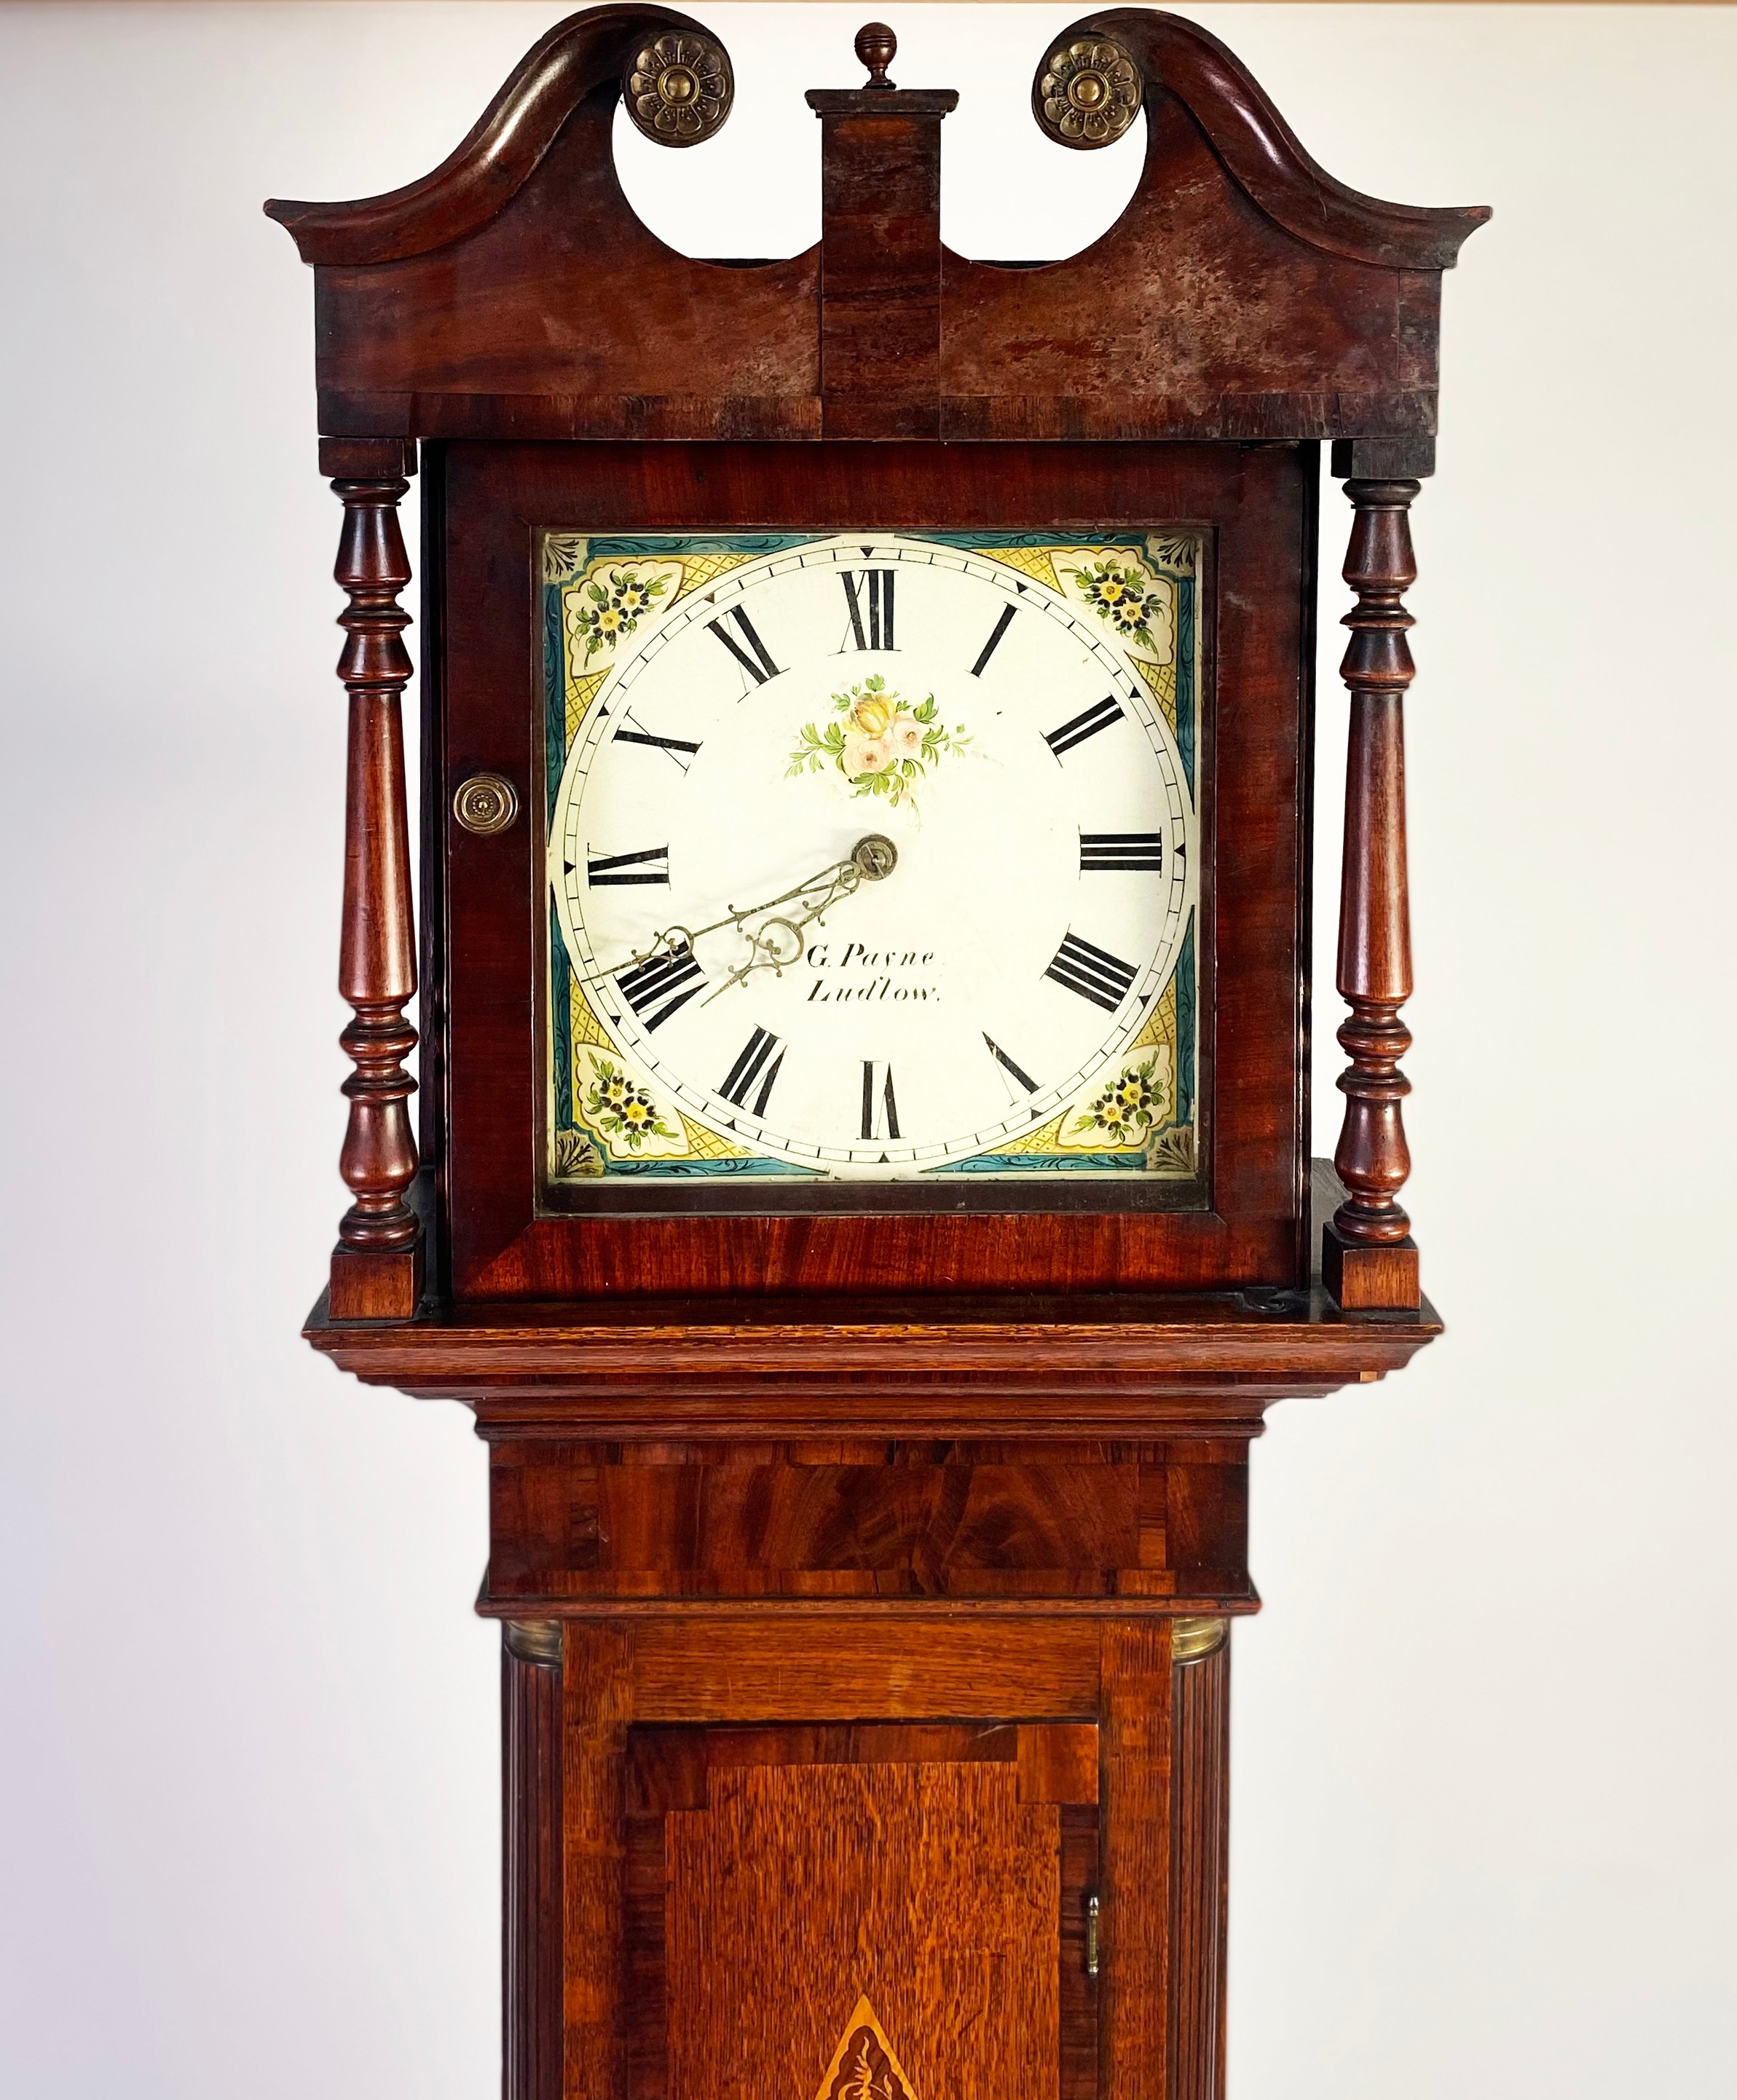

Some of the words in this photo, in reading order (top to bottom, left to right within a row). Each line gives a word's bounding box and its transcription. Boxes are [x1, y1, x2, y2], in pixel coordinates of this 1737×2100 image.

[828, 569, 902, 656] XII
[967, 602, 1018, 677] I
[704, 601, 791, 703] XI
[612, 706, 704, 777] X
[1040, 692, 1128, 769] II
[587, 842, 672, 890] IX
[1079, 825, 1163, 880] III
[613, 939, 710, 1034] VIII
[806, 976, 940, 1002] Ludlow.
[807, 943, 832, 968] G.
[1039, 923, 1141, 1019] IIII
[712, 1024, 787, 1119] VII
[857, 1060, 905, 1141] VI
[981, 1030, 1047, 1107] V
